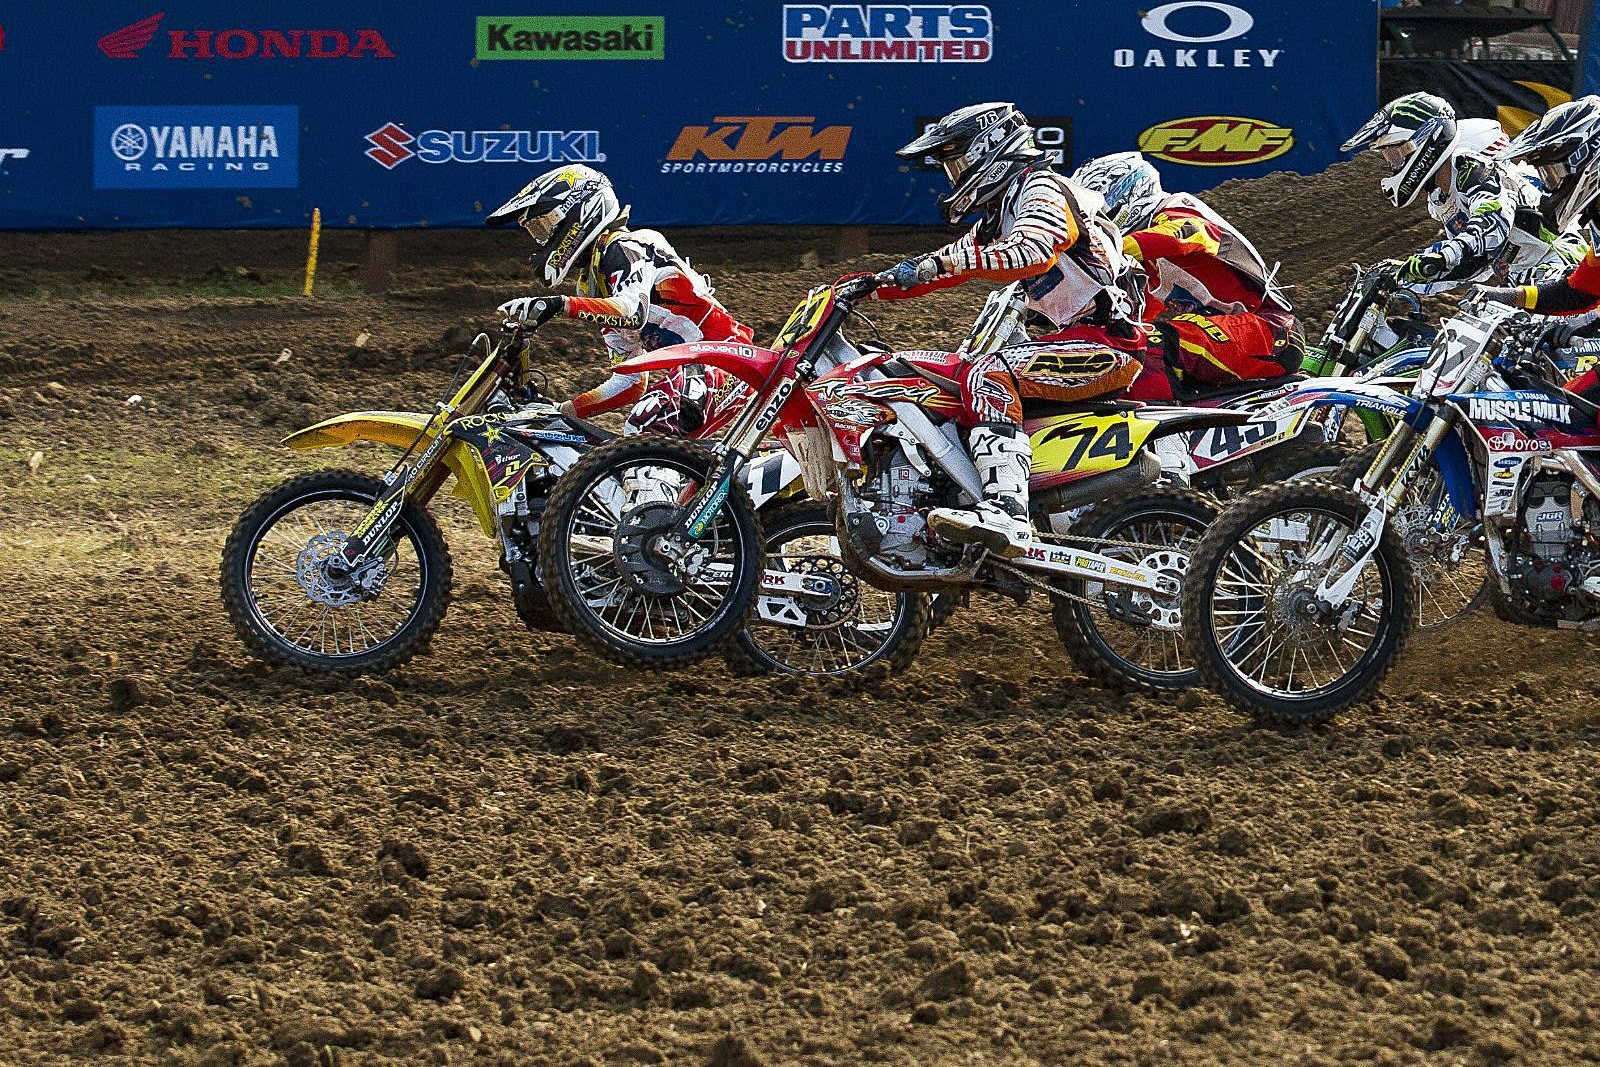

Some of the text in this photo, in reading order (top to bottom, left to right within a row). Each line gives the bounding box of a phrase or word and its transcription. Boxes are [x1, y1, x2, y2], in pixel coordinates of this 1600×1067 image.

[487, 23, 654, 52] Kawasaki
[782, 4, 993, 39] PARTS
[167, 30, 395, 59] HONDA
[783, 39, 993, 63] UNLIMITED
[1113, 48, 1280, 68] OAKLEY
[976, 111, 999, 129] 76
[150, 125, 279, 159] YAMAHA
[417, 130, 600, 163] SUZUKI
[665, 116, 853, 161] KTM
[1139, 121, 1294, 154] FMF
[125, 162, 270, 171] RACING
[661, 162, 844, 175] SPORTMOTORCYCLES
[755, 383, 793, 432] enzo
[1355, 399, 1408, 418] TRIANGLE
[1469, 398, 1571, 425] MUSCLE MILK
[1040, 421, 1134, 472] 74
[683, 480, 719, 530] DUNLOP
[701, 489, 729, 525] MOTOREX
[361, 499, 401, 547] DUNLOP
